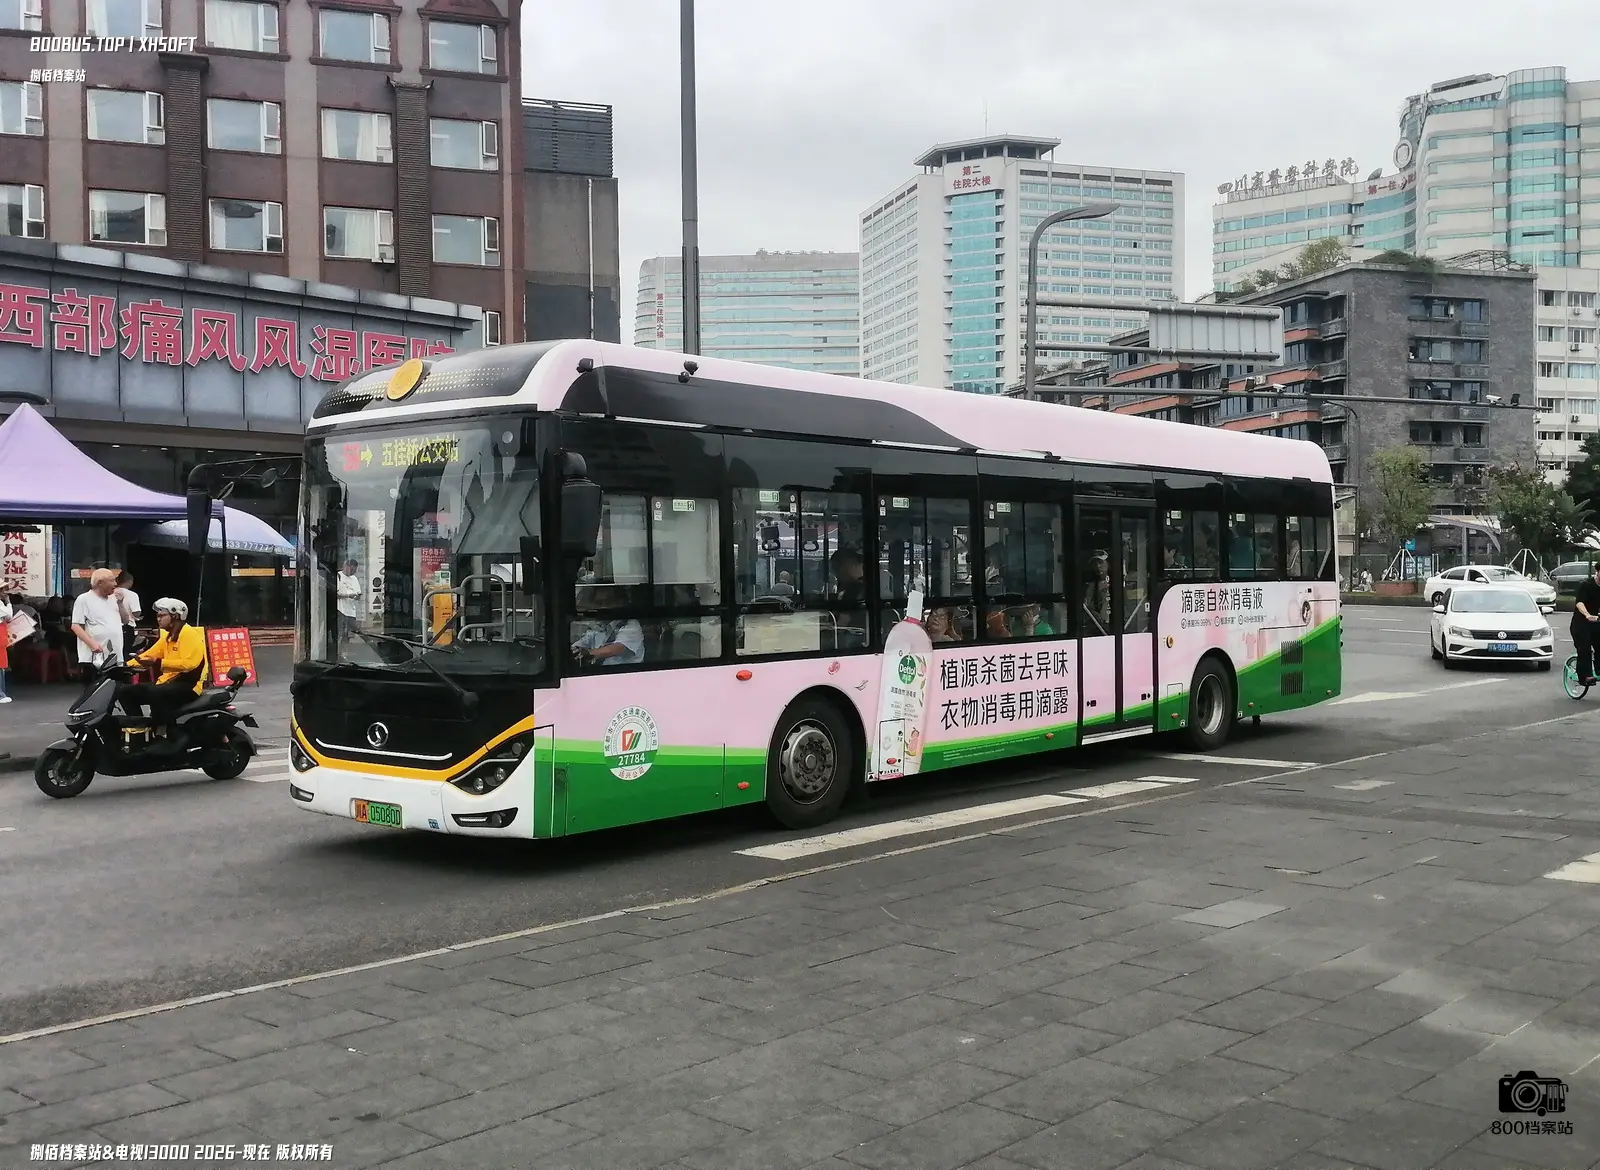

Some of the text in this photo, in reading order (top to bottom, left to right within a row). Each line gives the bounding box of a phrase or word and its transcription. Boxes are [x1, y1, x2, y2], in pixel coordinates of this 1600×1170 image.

[953, 175, 991, 190] 住院大楼
[963, 165, 981, 176] 第二
[656, 293, 664, 338] 第三住院大楼
[381, 433, 459, 467] 五桂桥公交站
[1181, 587, 1264, 614] 滴露自然消毒液
[940, 649, 1069, 691] 植源杀菌去异味
[940, 686, 1069, 731] 衣物消毒用滴露
[618, 752, 646, 766] 27784
